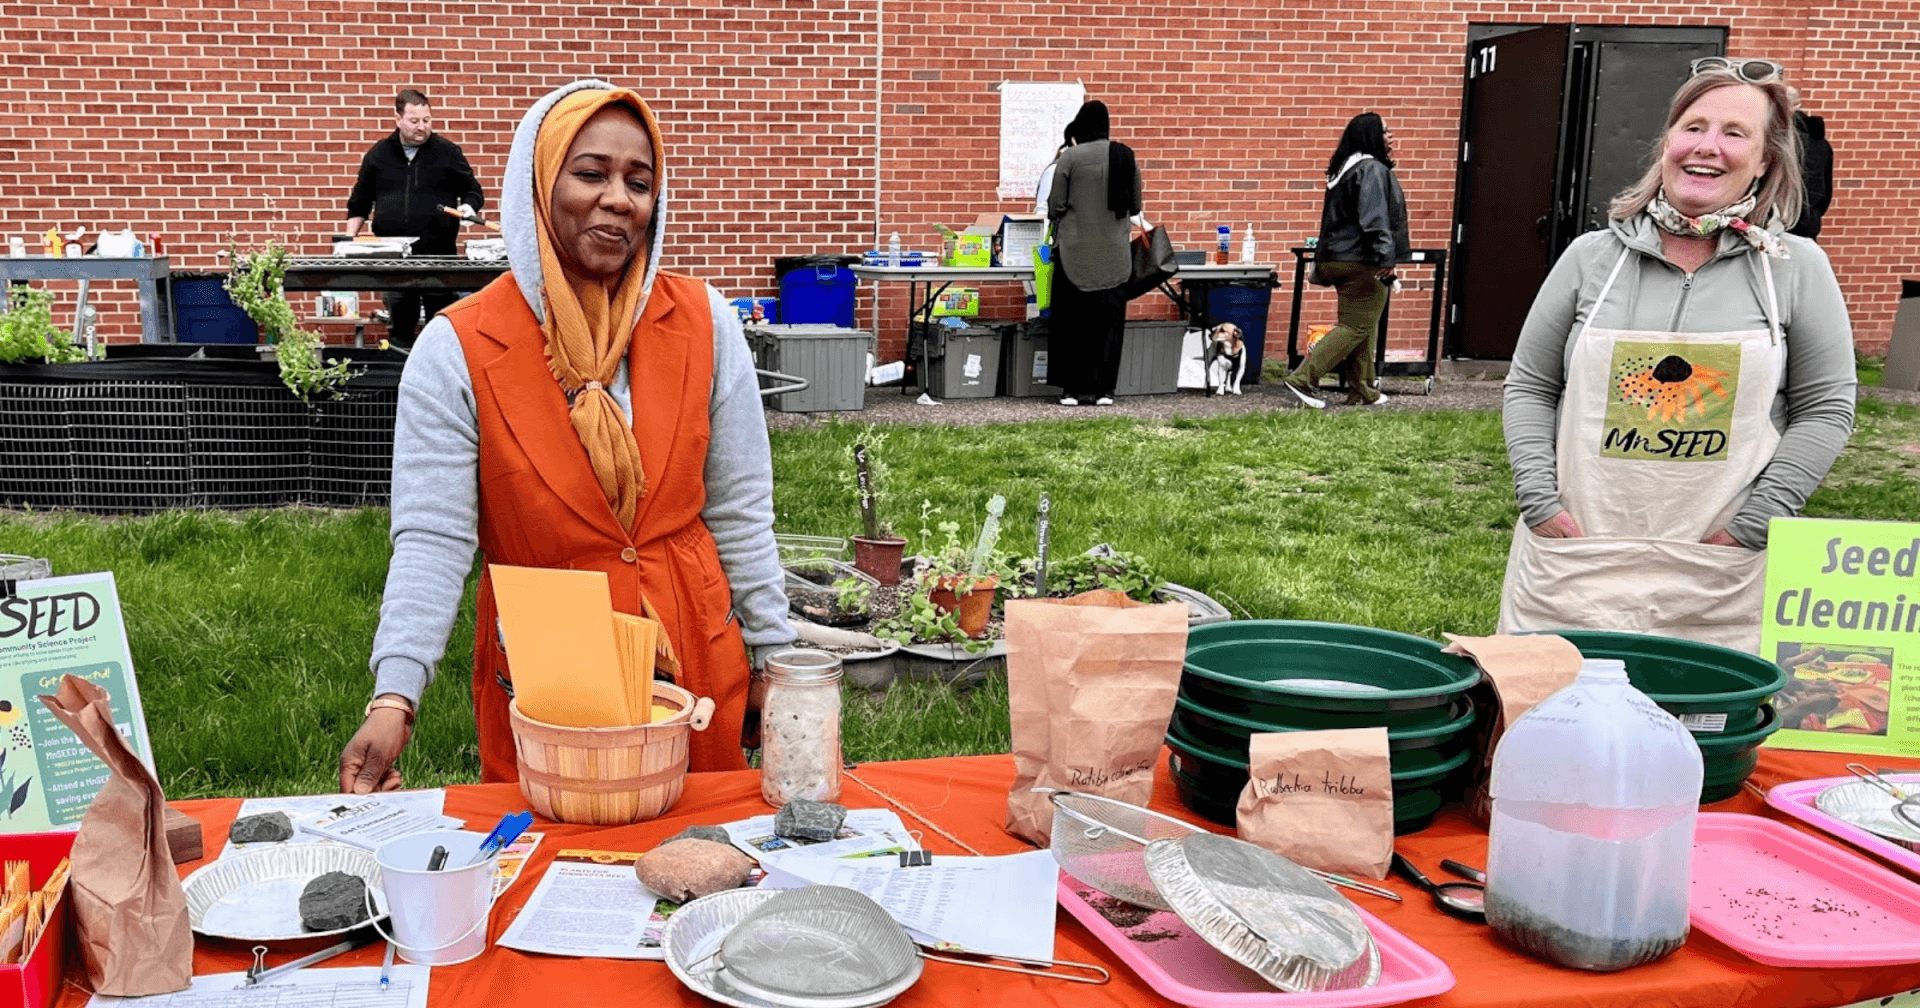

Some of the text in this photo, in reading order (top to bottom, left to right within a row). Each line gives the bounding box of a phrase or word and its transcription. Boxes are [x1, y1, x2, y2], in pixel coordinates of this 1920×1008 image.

[1480, 44, 1497, 73] 11
[1821, 536, 1920, 578] Seed
[37, 639, 68, 649] Science
[68, 635, 97, 645] Project
[61, 736, 74, 746] the
[45, 747, 78, 760] MnSEED
[1321, 770, 1364, 795] triloba
[56, 795, 81, 806] saving
